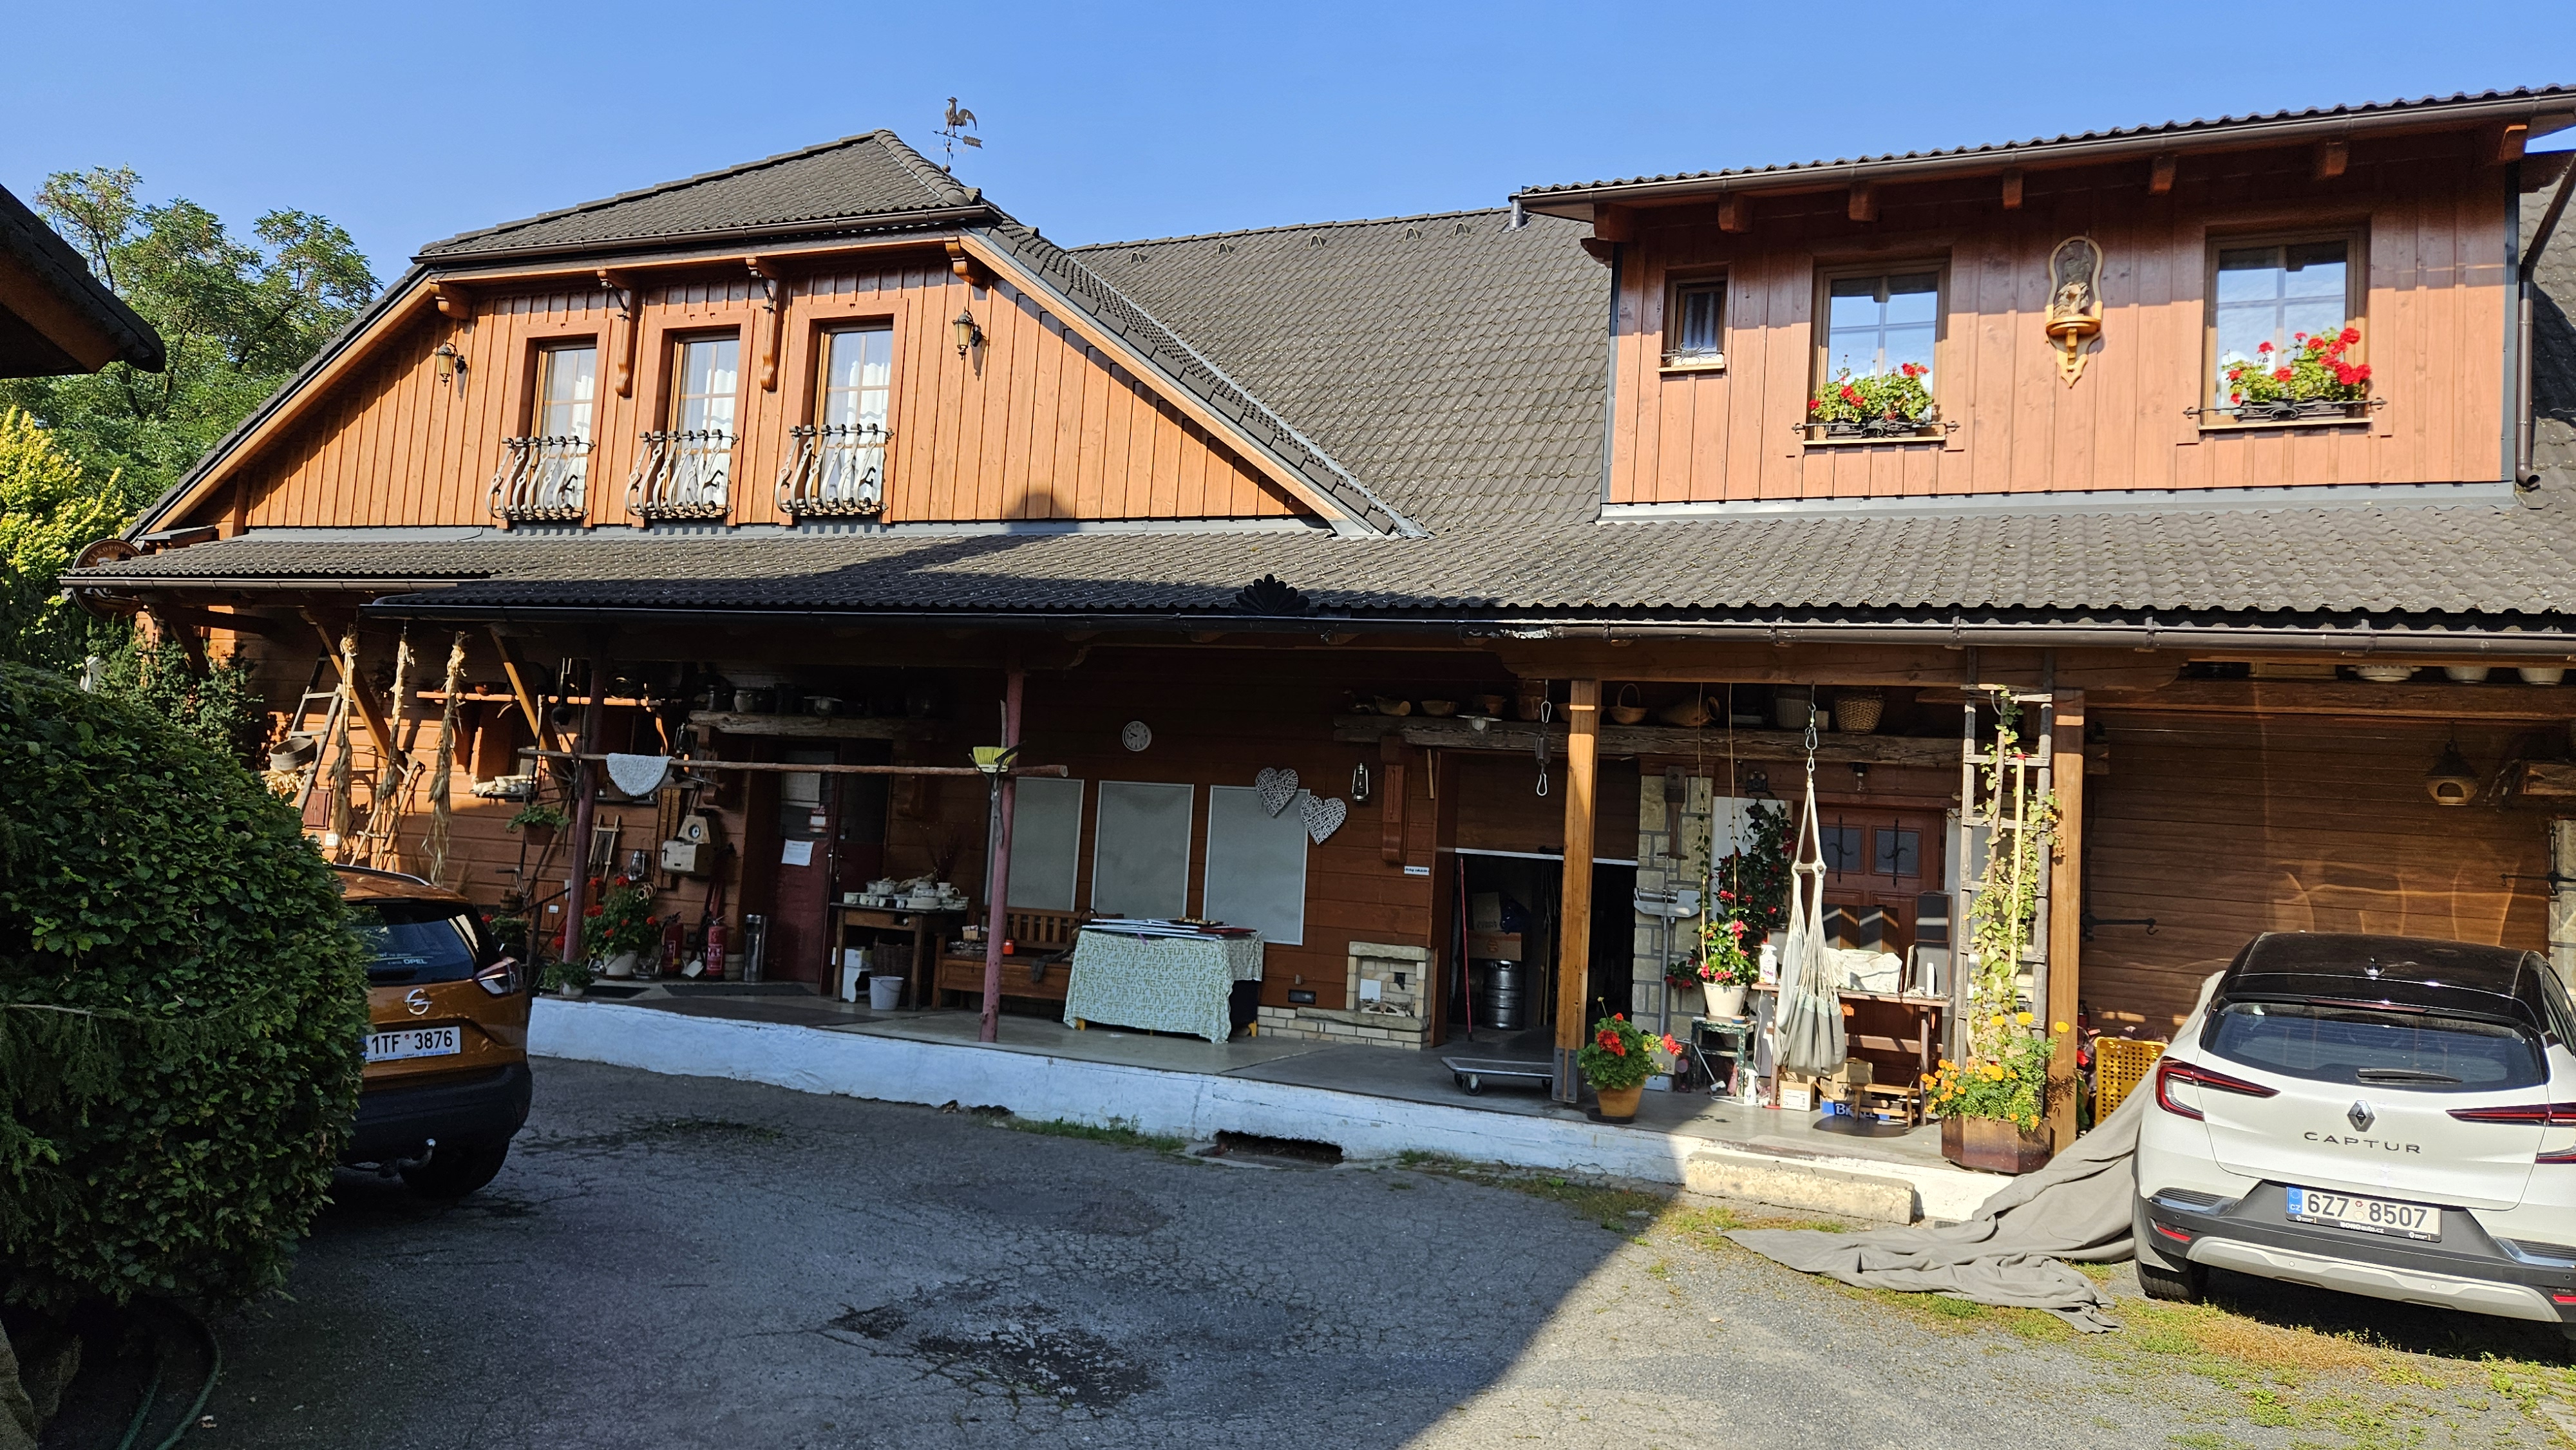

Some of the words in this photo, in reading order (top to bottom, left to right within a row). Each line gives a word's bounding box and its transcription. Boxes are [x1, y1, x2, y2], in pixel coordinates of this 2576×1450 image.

[372, 1034, 401, 1054] 1TF
[414, 1030, 453, 1050] 3876
[2304, 1131, 2421, 1154] CAPTUR
[2307, 1193, 2349, 1218] 6Z7
[2369, 1202, 2427, 1229] 8507
